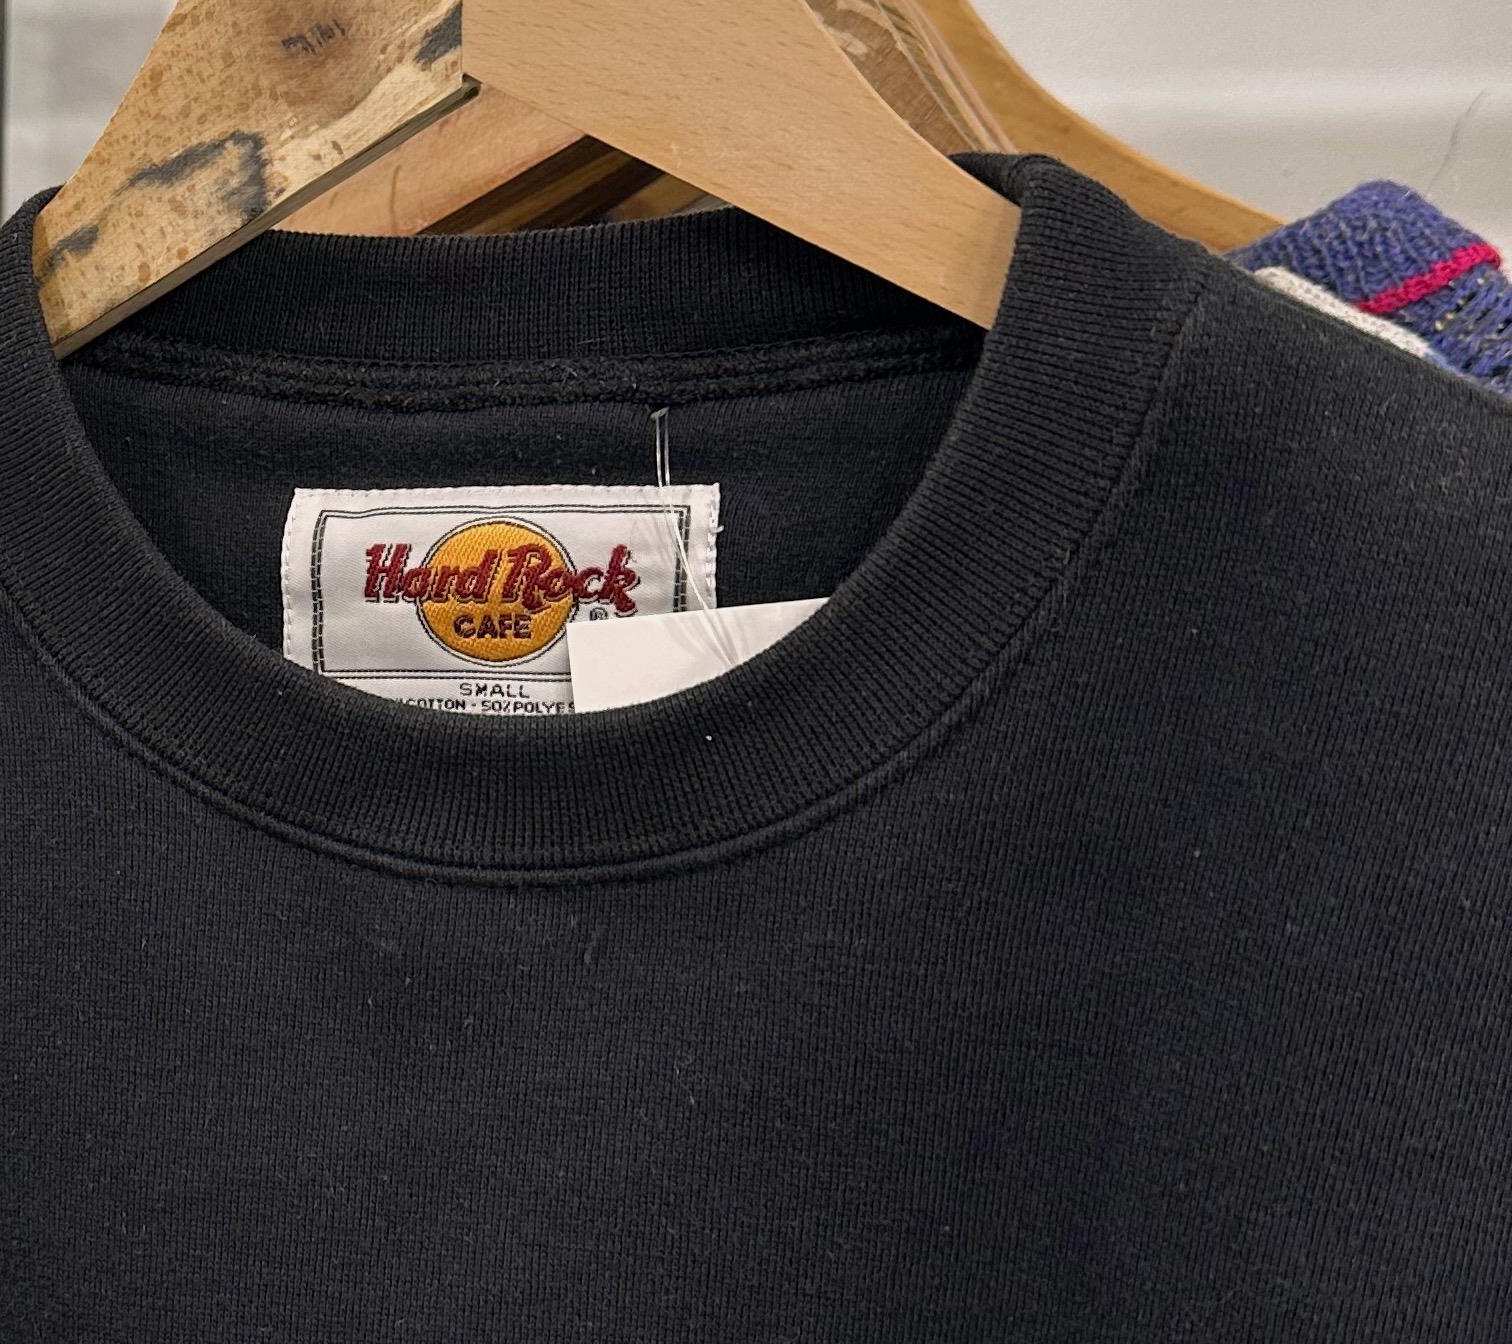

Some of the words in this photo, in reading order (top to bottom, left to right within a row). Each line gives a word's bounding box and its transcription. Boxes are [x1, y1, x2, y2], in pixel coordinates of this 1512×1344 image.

[364, 542, 501, 602] Hard
[501, 542, 640, 616] Rock
[453, 614, 532, 639] CAFE
[459, 682, 530, 699] SMALL
